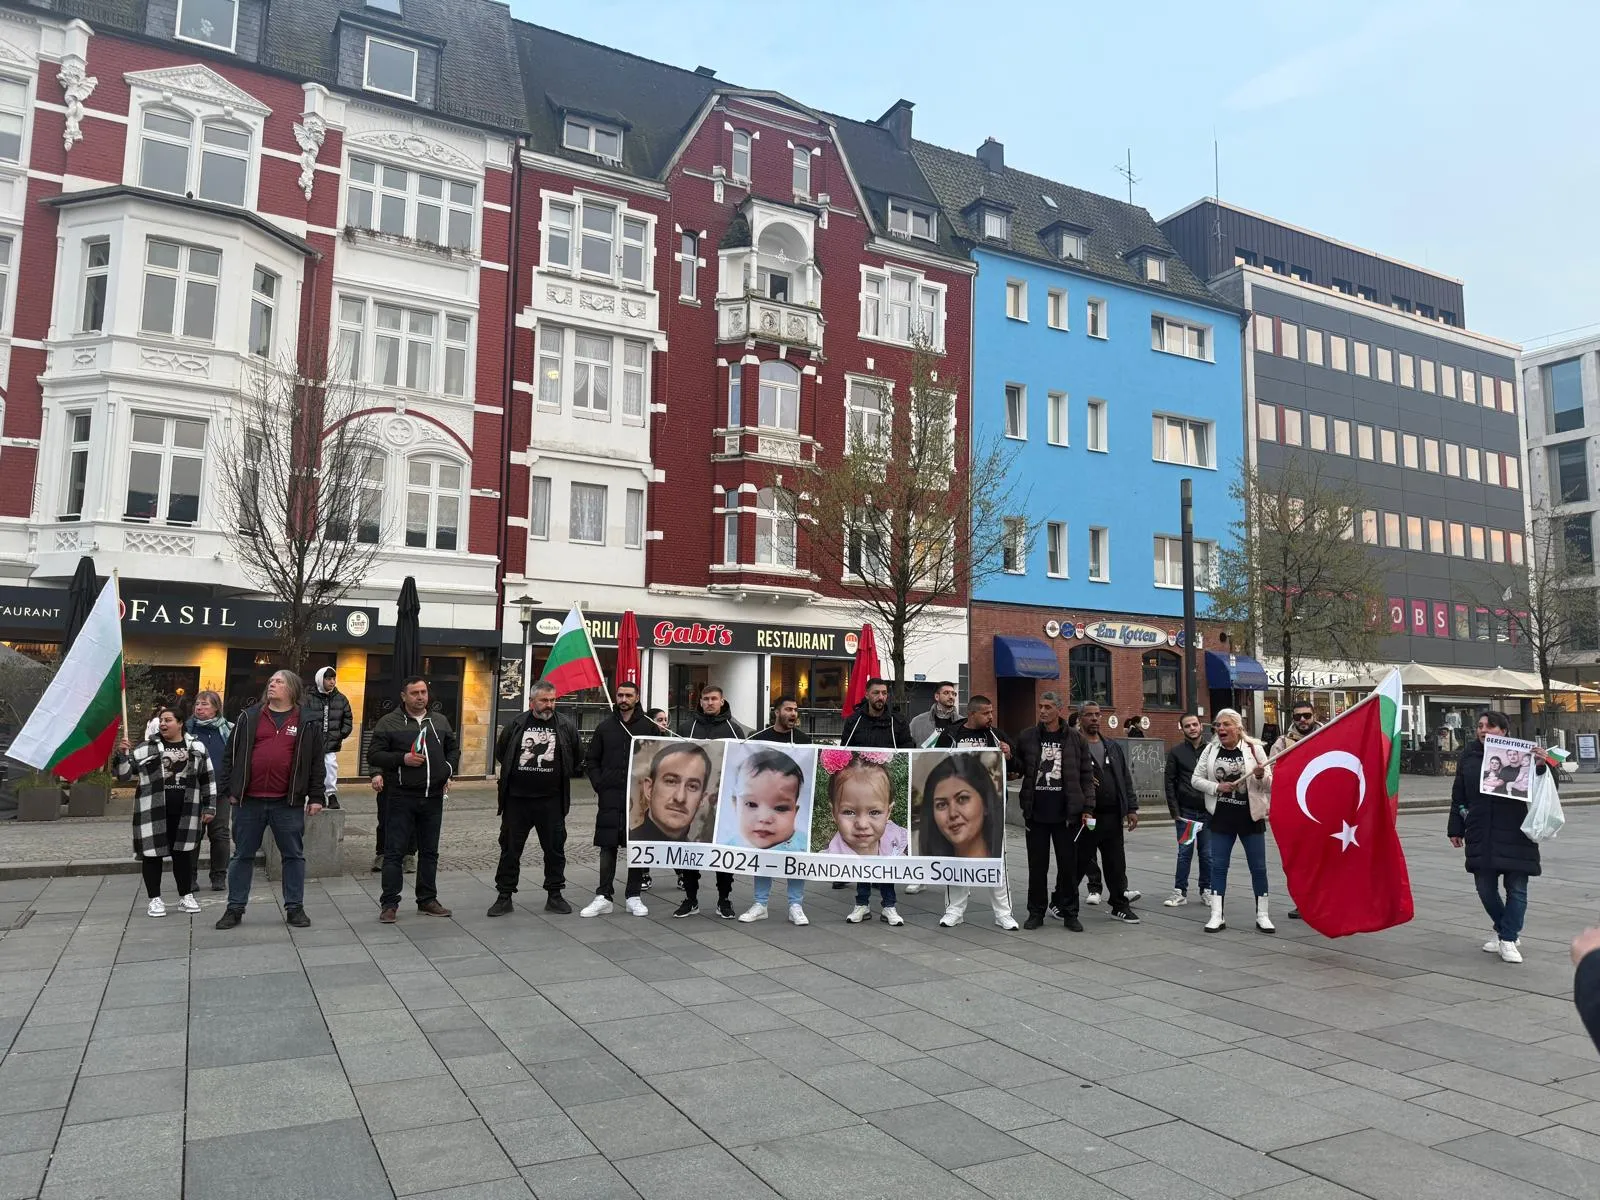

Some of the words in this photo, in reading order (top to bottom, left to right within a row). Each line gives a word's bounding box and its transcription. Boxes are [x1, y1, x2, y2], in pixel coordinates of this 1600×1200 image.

[129, 599, 237, 627] FASIL
[316, 622, 338, 632] BAR
[1119, 625, 1158, 645] Kotten
[757, 629, 836, 651] RESTAURANT
[630, 846, 660, 865] 25.
[709, 849, 760, 872] 2024
[784, 856, 925, 880] BRANDANSCHLAG
